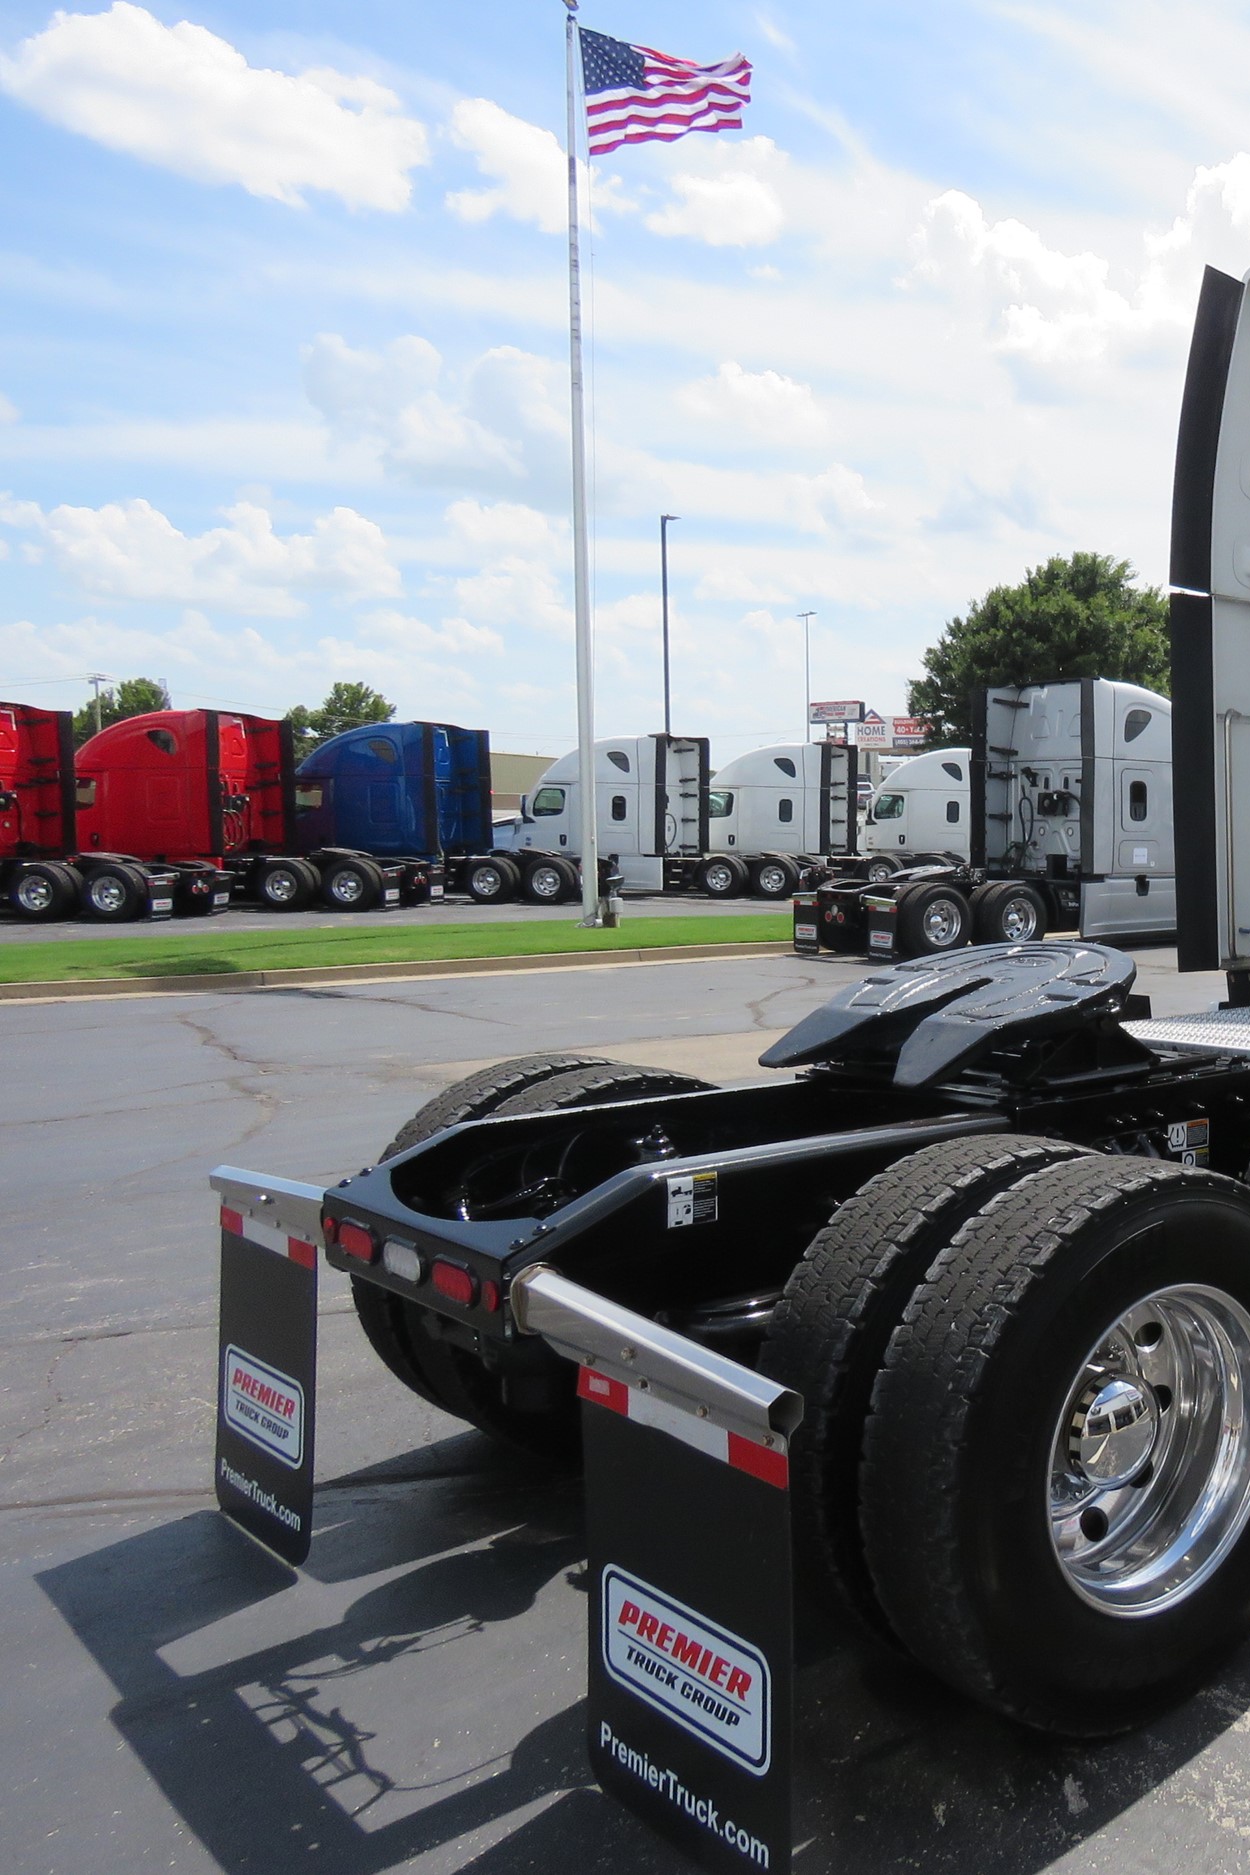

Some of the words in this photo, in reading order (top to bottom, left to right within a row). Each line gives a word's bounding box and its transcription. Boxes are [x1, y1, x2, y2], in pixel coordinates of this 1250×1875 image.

[857, 726, 886, 736] HOME
[232, 1367, 296, 1420] PREMIER
[235, 1399, 260, 1425] TRUCK
[260, 1415, 289, 1440] GROUP
[221, 1457, 301, 1532] PremierTruck.com
[617, 1600, 752, 1702] PREMIER
[626, 1645, 680, 1690] TRUCK
[680, 1680, 741, 1727] GROUP
[600, 1720, 770, 1869] PremierTruck.com
